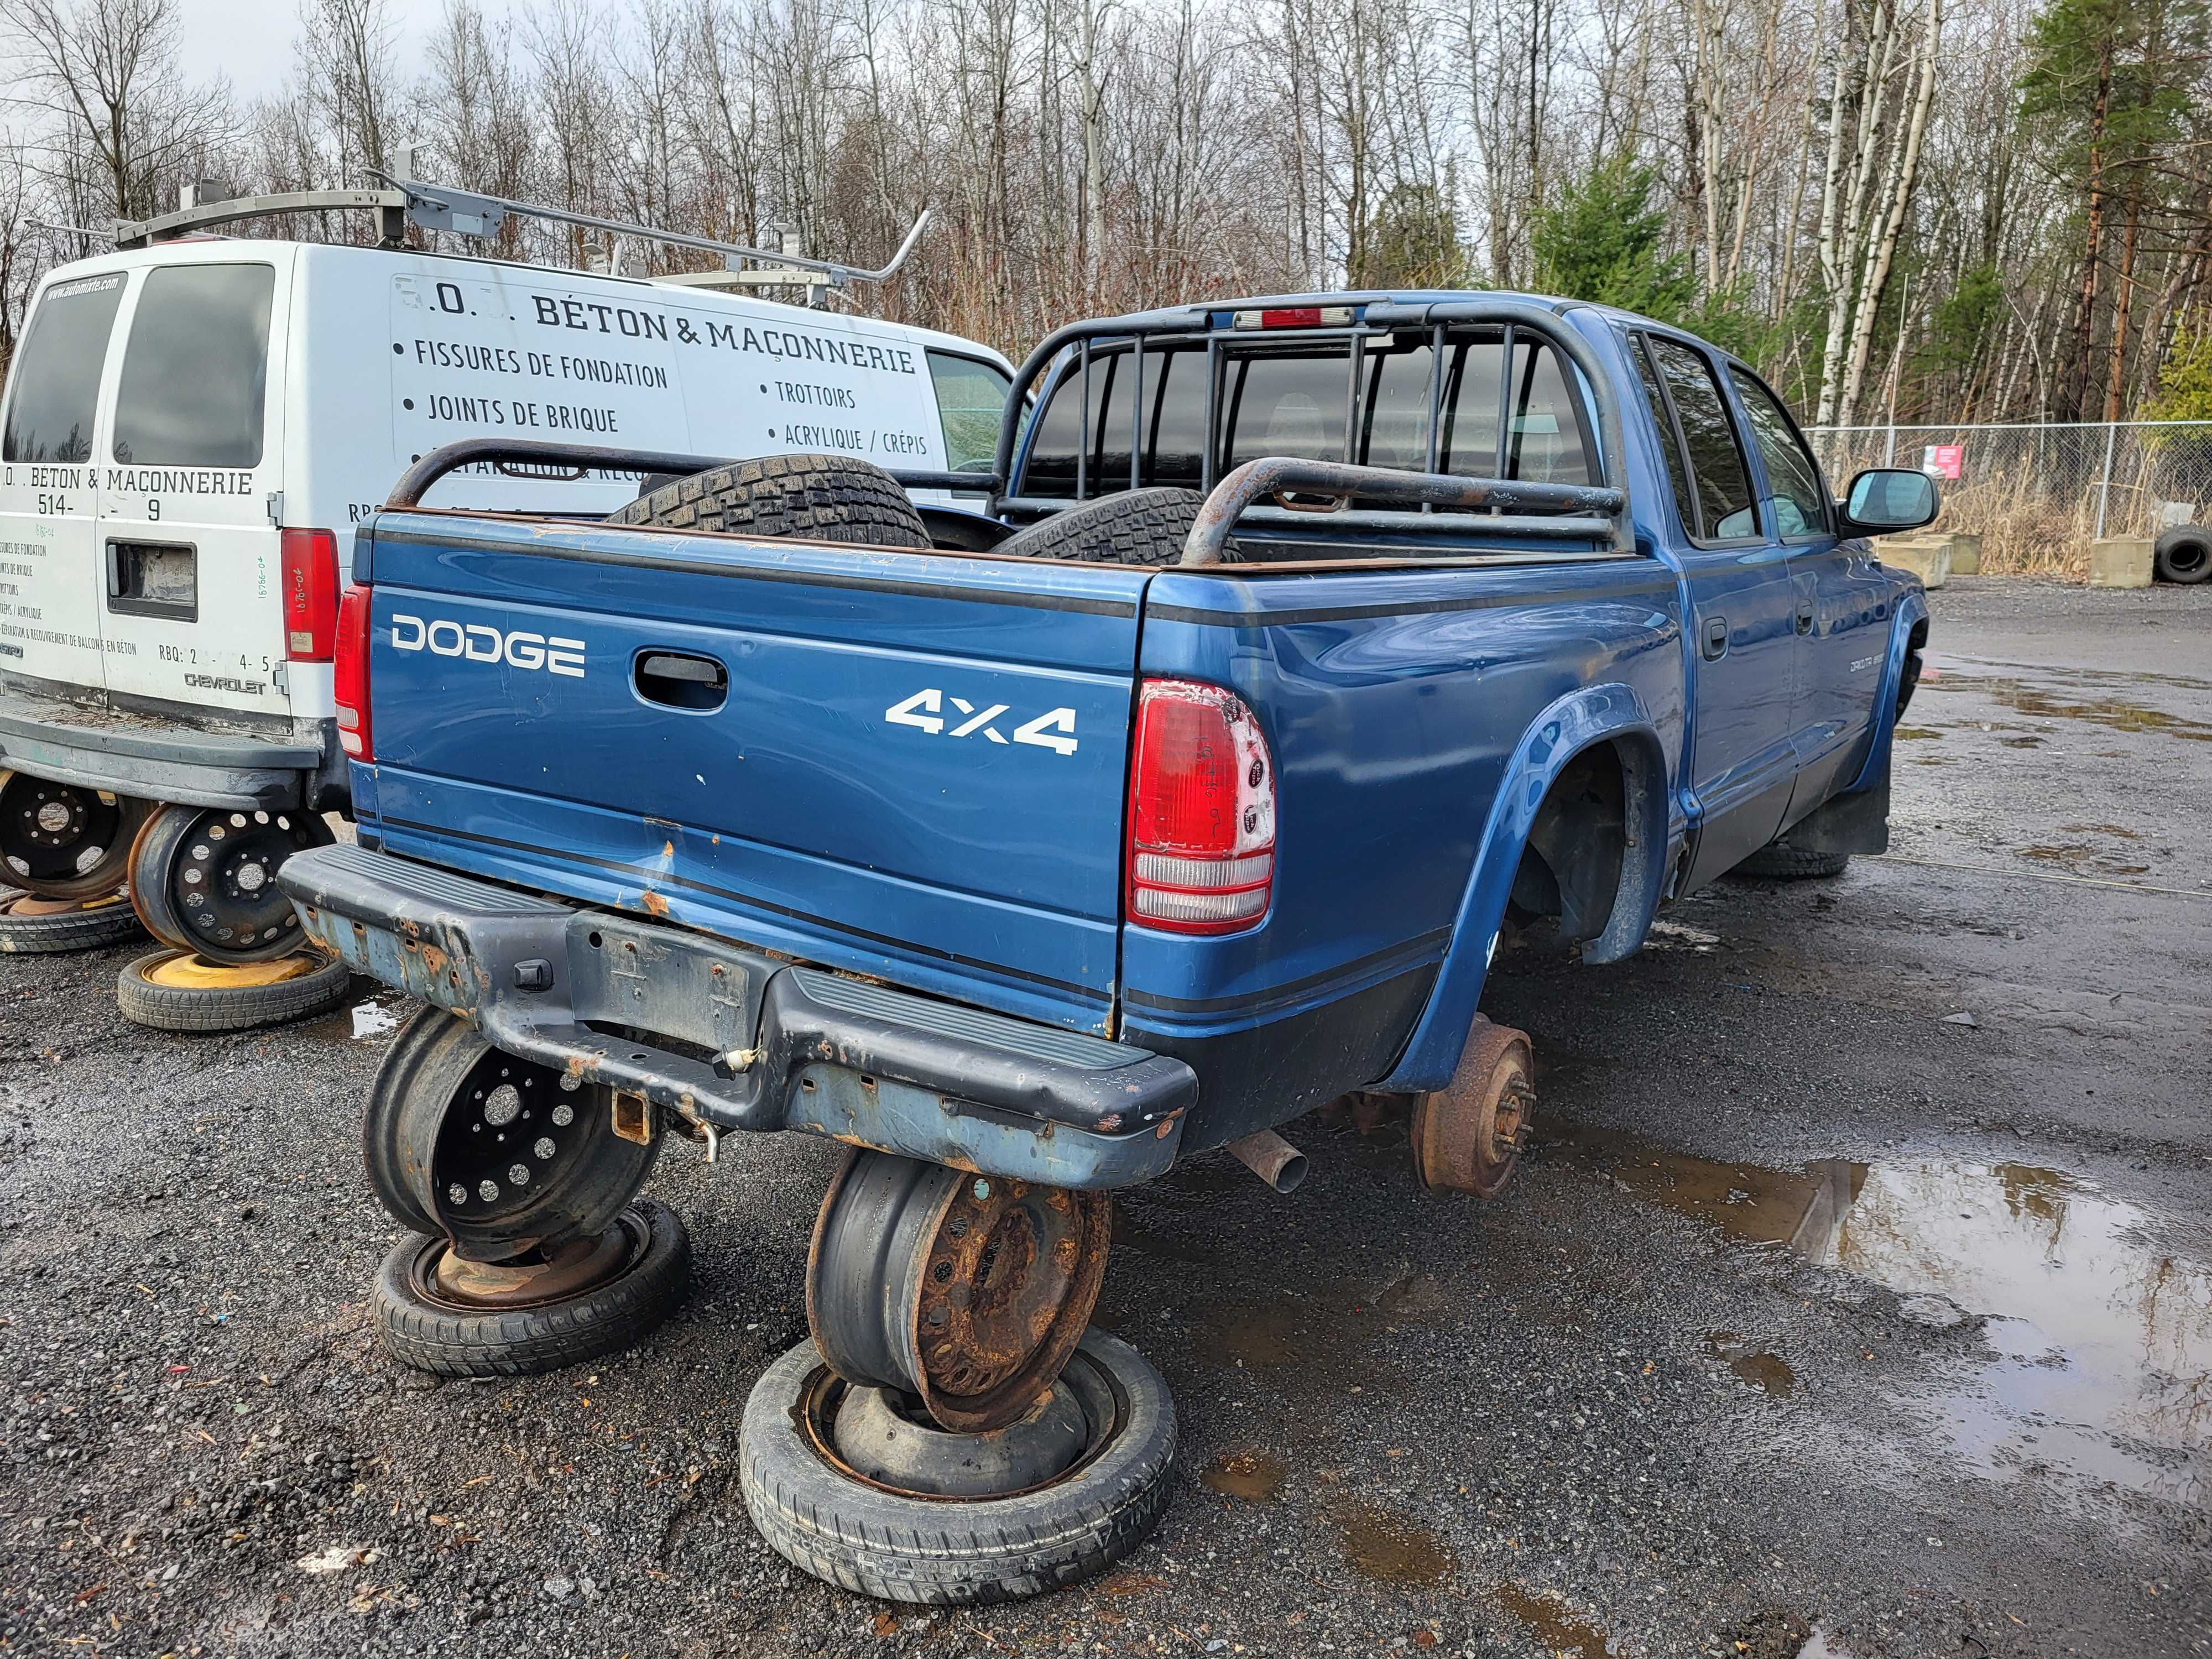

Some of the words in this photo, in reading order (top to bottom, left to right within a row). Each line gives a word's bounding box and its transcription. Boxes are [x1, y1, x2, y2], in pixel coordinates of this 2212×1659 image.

[48, 278, 119, 301] www.automixte.com
[531, 294, 669, 341] BÉTON
[676, 317, 702, 345] &
[705, 321, 915, 374] MAÇONNERIE
[415, 340, 521, 373] FISSURES
[528, 352, 555, 377] DE
[560, 356, 667, 389] FONDATION
[775, 381, 855, 409] TROTTOIRS
[428, 394, 505, 424] JOINTS
[512, 401, 540, 427] DE
[546, 404, 618, 433] BRIQUE
[785, 424, 863, 451] ACRYLIQUE
[883, 430, 927, 455] CRÉPIS
[32, 465, 81, 489] BÉTON
[88, 469, 98, 489] &
[107, 469, 252, 497] MAÇONNERIE
[148, 499, 160, 520] 9
[14, 543, 20, 554] DE
[21, 544, 46, 557] FONDATION
[11, 564, 15, 575] DE
[17, 564, 33, 577] BRIQUE
[18, 606, 42, 620] ACRYLIQUE
[0, 642, 23, 659] STRO
[1, 622, 25, 638] RÉPARATION
[30, 629, 67, 645] RECOUVREMENT
[70, 635, 76, 647] DE
[78, 636, 105, 651] BALCONS
[107, 640, 116, 653] EN
[117, 639, 137, 655] BÉTON
[392, 614, 586, 678] DODGE
[159, 645, 183, 662] RBQ:
[184, 673, 266, 695] CHEVROLET
